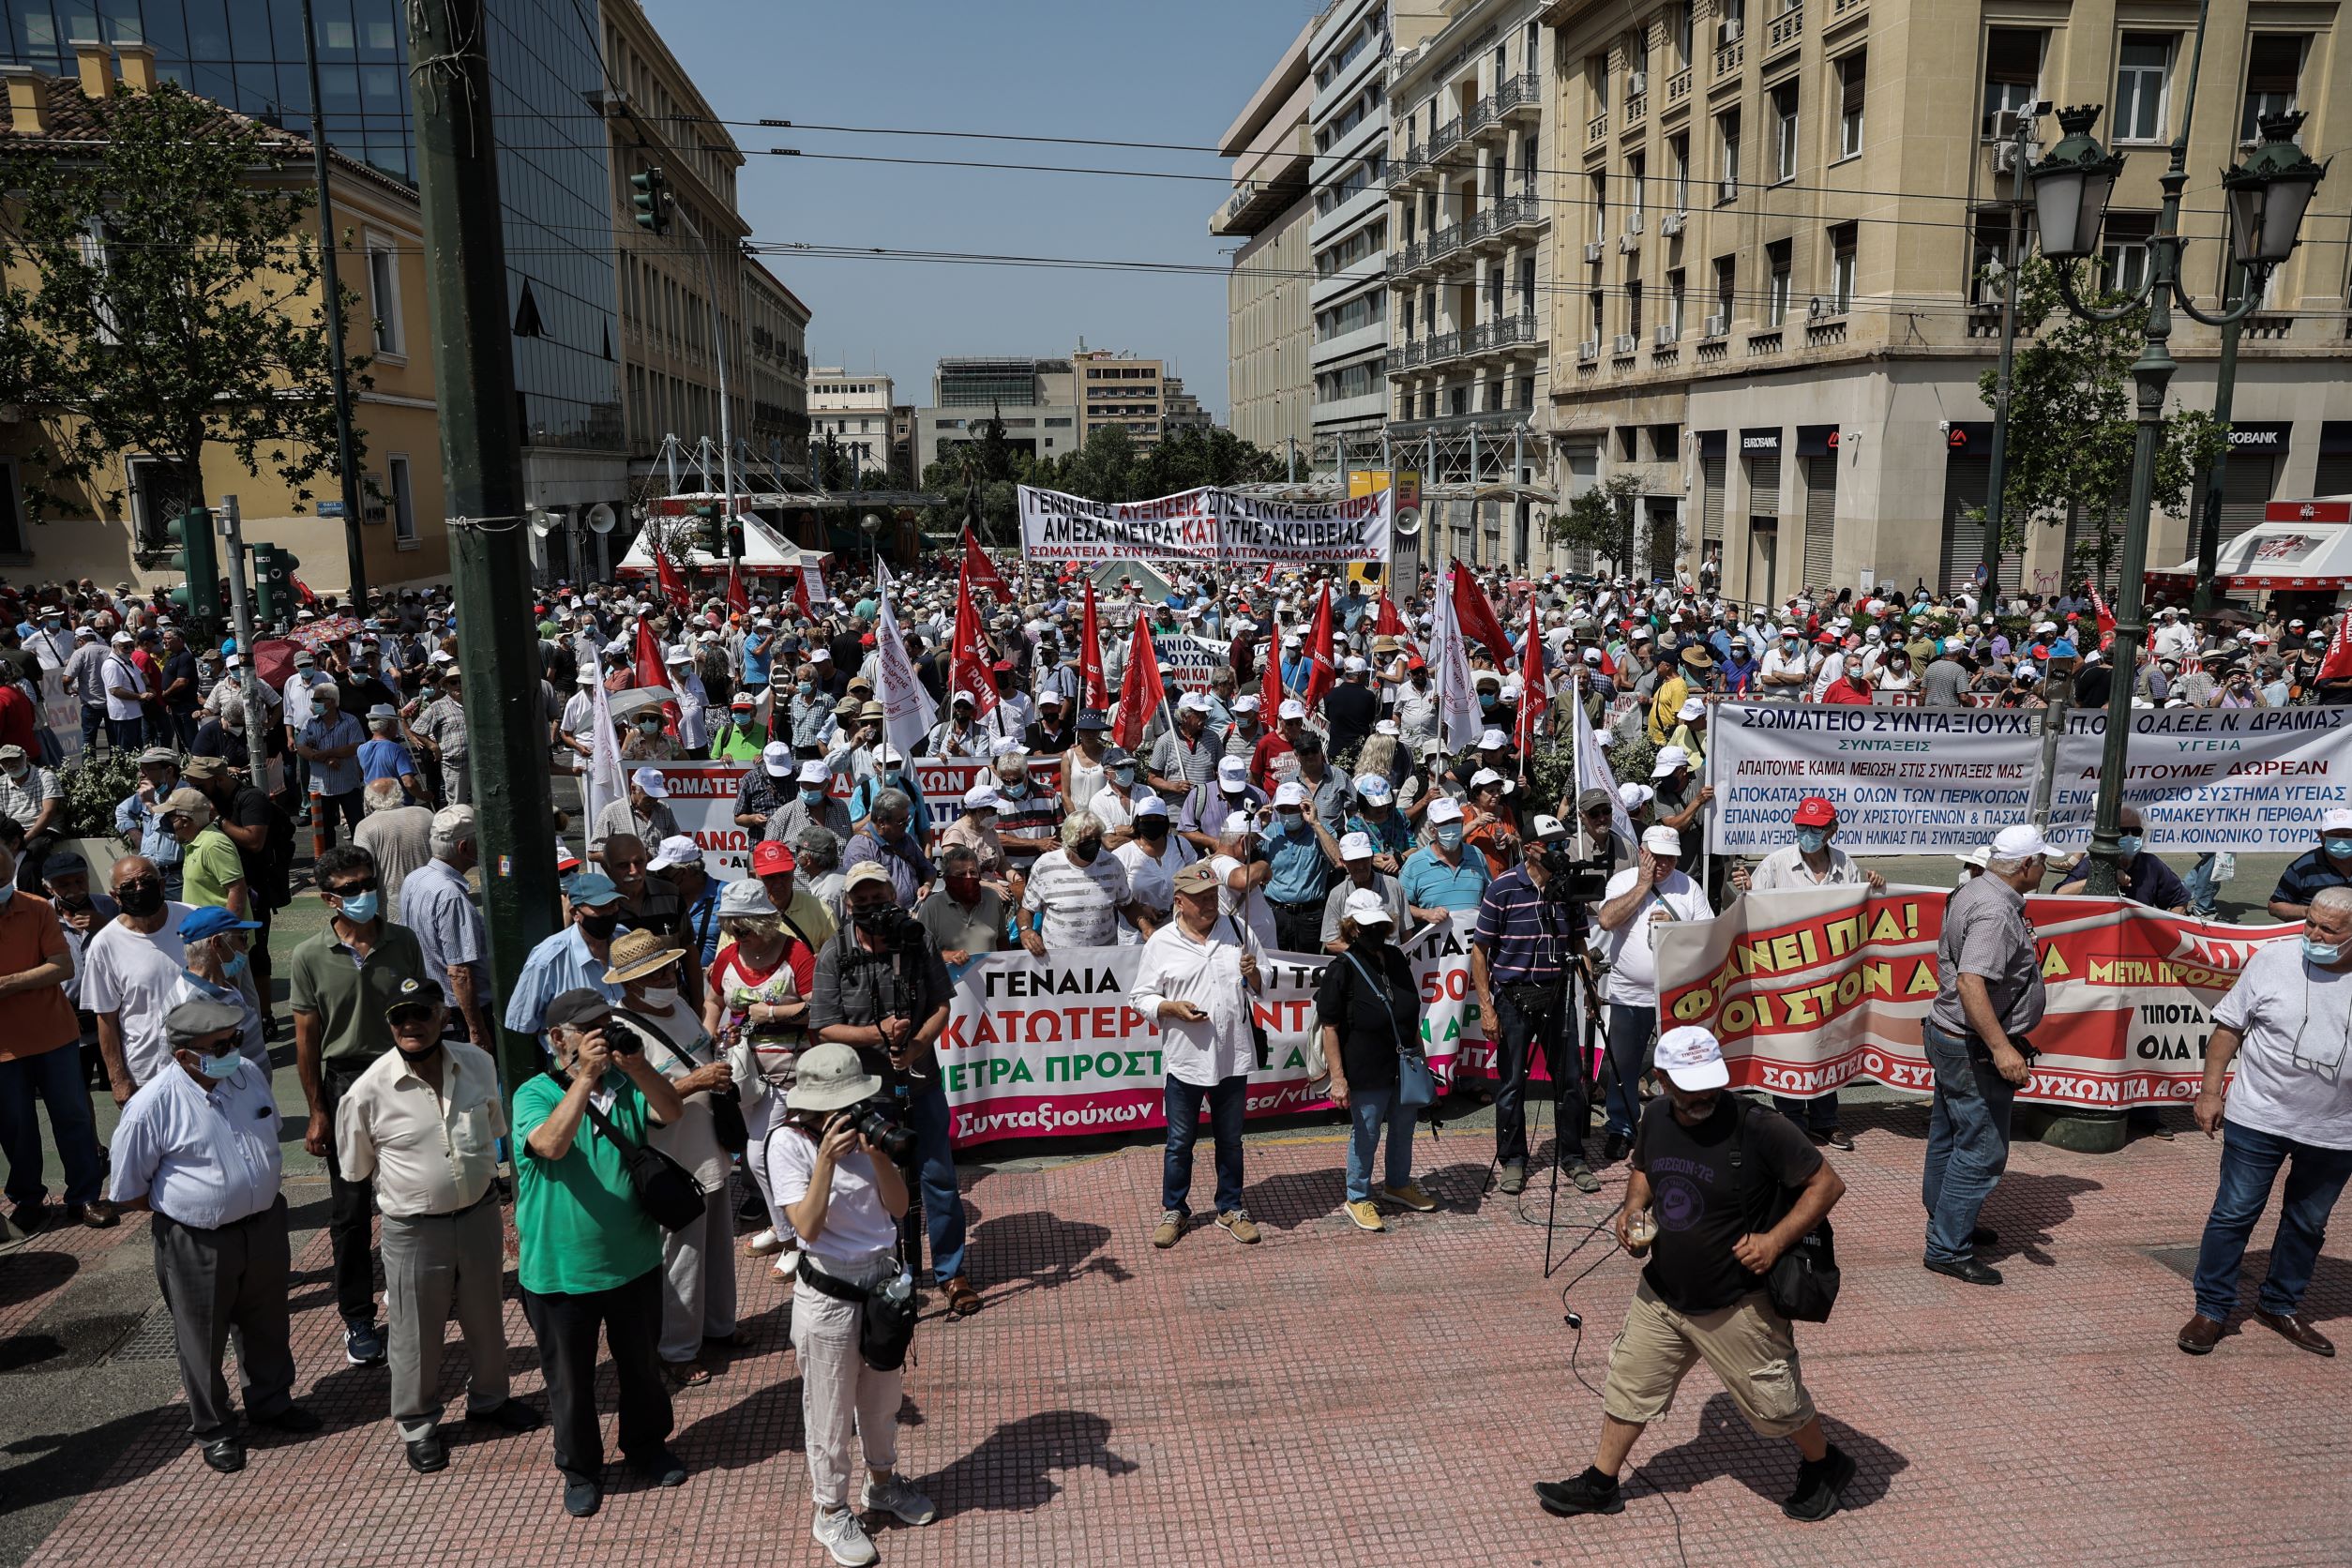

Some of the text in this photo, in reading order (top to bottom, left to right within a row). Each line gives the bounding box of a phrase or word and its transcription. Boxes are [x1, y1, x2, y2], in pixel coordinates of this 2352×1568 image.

[1743, 437, 1778, 448] EUROBANK
[2226, 431, 2278, 445] ROBANK
[1029, 490, 1380, 520] ΓΕΝΝΑΙΕΣ ΑΥΞΗΣΕΙΣ ΣΤΙΣ ΣΥΝΤΑΞΕΙΣ ΤΩΡΑ
[1044, 518, 1108, 543] ΑΜΕΣΑ
[1114, 521, 1175, 544] ΜΕΤΡΑ
[1270, 521, 1366, 546] ΑΚΡΙΒΕΙΑΣ
[1030, 546, 1107, 558] ΣΩΜΑΤΕΙΑ
[1224, 547, 1380, 560] ΑΙΤΩΛΟΑΚΑΡΝΑΝΙΑΣ
[1741, 708, 1865, 731] ΣΩΜΑΤΕΙΟ
[2136, 714, 2212, 734] Ο.Α.Ε.Ε.
[2220, 714, 2239, 731] Ν.
[2249, 709, 2344, 731] ΔΡΑΜΑΣ
[1838, 739, 1932, 752] ΣΥΝΤΑΞΕΙΣ
[2178, 740, 2241, 752] ΥΓΕΙΑ
[1737, 760, 2025, 778] ΑΠΑΙΤΟΥΜΕ ΚΑΜΙΑ ΜΕΙΩΣΗ ΣΤΙΣ ΣΥΝΤΑΞΕΙΣ ΜΑΣ
[2227, 761, 2329, 776] ΔΩΡΕΑΝ
[1728, 787, 2029, 804] ΑΠΟΚΑΤΑΣΤΑΣΗ ΟΛΩΝ ΤΩΝ ΠΕΡΙΚΟΠΩΝ
[2198, 786, 2284, 802] ΣΥΣΤΗΜΑ
[2285, 786, 2347, 801] ΥΓΕΙΑΣ
[1862, 808, 1965, 824] ΧΡΙΣΤΟΥΓΕΝΝΩΝ
[1970, 811, 1979, 824] &
[1983, 810, 2026, 824] ΠΑΣΧΑ
[2050, 810, 2074, 823] ΚΑΙ
[1725, 830, 1756, 845] ΚΑΜΙΑ
[1866, 830, 1907, 845] ΗΛΙΚΙΑΣ
[1911, 831, 1926, 845] ΓΙΑ
[2181, 828, 2263, 843] ΚΟΙΝΩΝΙΚΟ
[1673, 904, 1920, 1020] ΦΤΑΝΕΙ ΠΙΑ!
[2088, 958, 2151, 984] ΜΕΤΡΑ
[986, 967, 1122, 998] ΓΕΝΑΙΑ
[1781, 962, 1892, 1026] ΣΤΟΝ
[2141, 1004, 2205, 1024] ΤΙΠΟΤΑ
[940, 1006, 1159, 1050] ΚΑΤΩΤΕΡ
[2136, 1034, 2192, 1060] ΟΛΑ
[1762, 1054, 1884, 1092] ΣΩΜΑΤΕΙΟ
[2123, 1077, 2149, 1102] ΙΚΑ
[957, 1101, 1153, 1138] Συνταξιούχων
